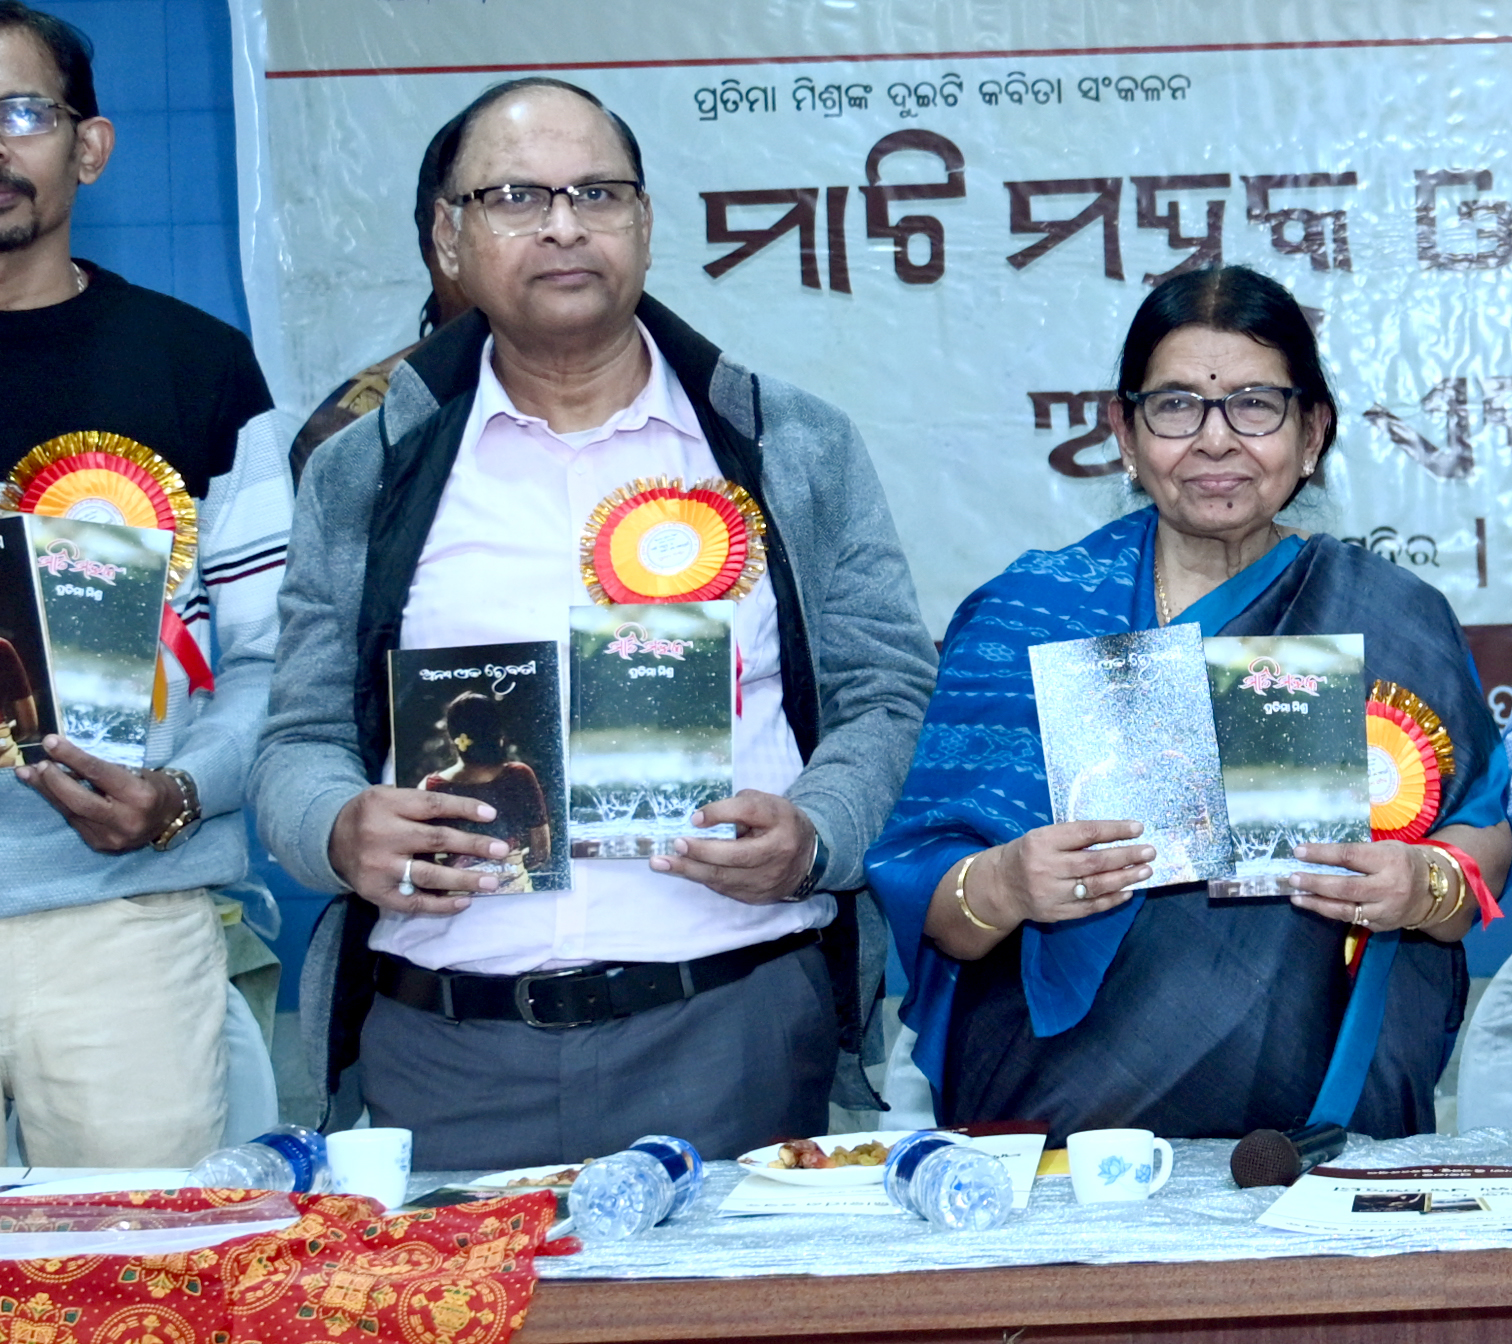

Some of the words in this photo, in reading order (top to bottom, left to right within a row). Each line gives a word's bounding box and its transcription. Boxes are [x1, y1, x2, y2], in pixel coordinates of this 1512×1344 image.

[694, 79, 777, 121] ପ୍ରତିମା
[887, 72, 964, 119] ଦୁଇଟି
[978, 71, 1062, 107] କବିତା
[1077, 73, 1192, 104] ସଂକଳନ
[699, 128, 967, 295] ମାଟି
